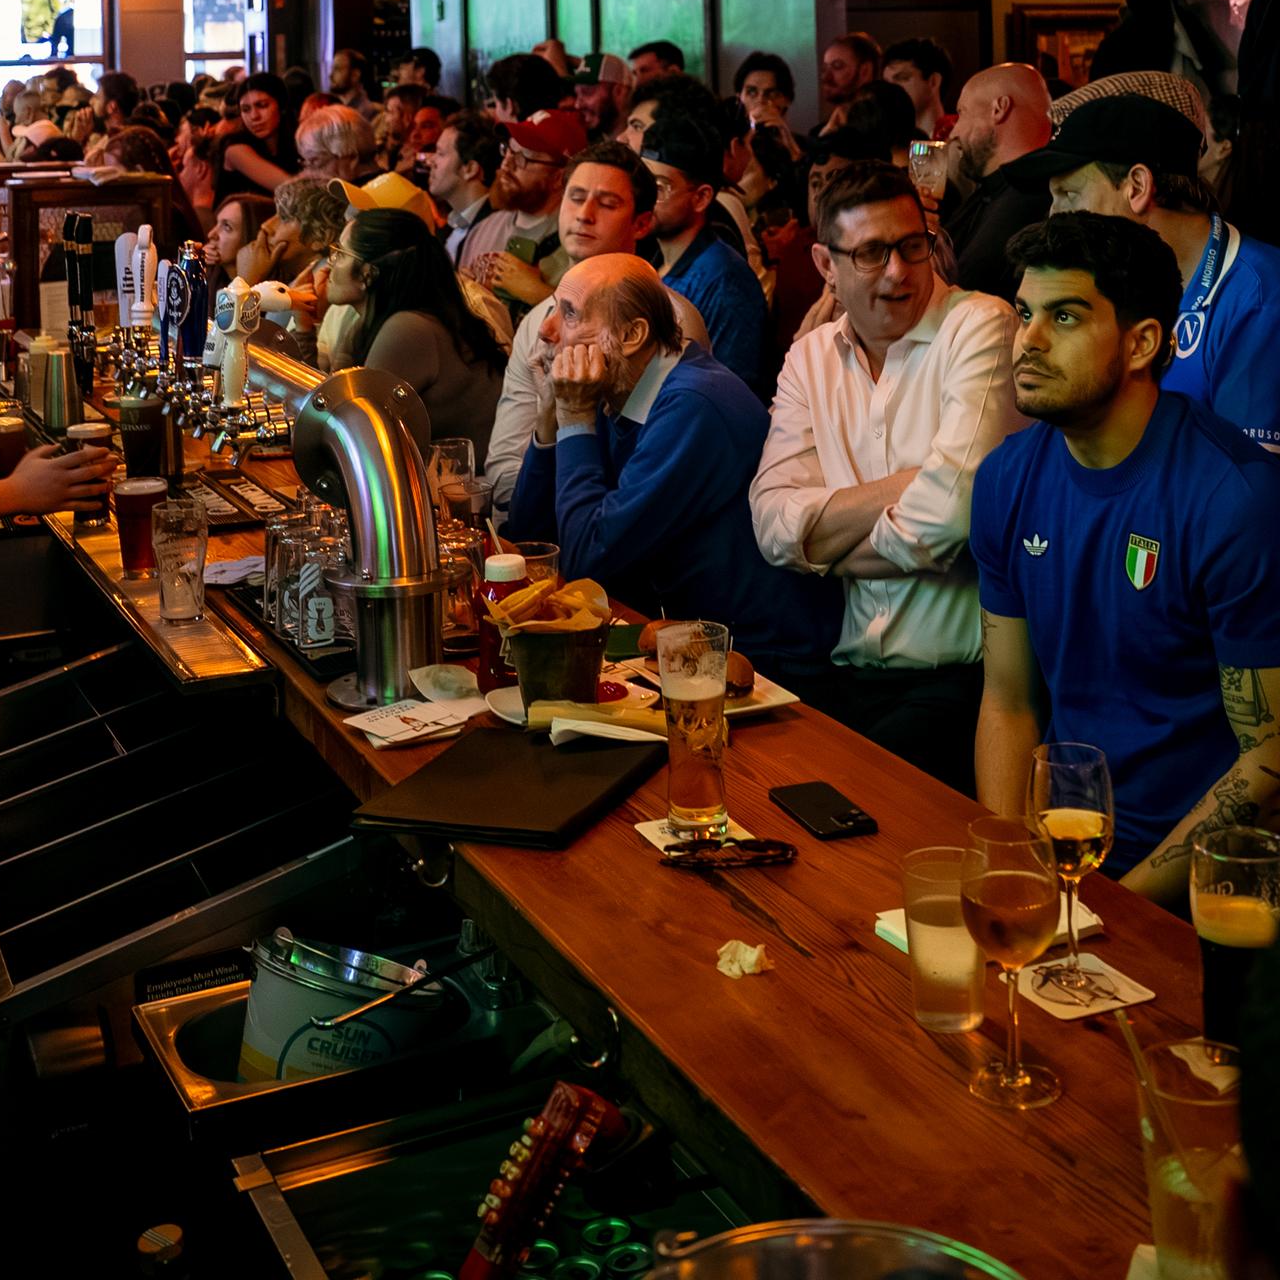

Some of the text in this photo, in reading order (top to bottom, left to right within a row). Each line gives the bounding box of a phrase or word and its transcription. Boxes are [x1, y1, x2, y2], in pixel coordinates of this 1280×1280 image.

[1180, 318, 1200, 346] N
[1130, 535, 1158, 552] ITALIA
[146, 963, 239, 994] Employees Must Wash
[175, 980, 203, 996] Before
[331, 1025, 373, 1046] SUN
[306, 1036, 384, 1064] CRUISER
